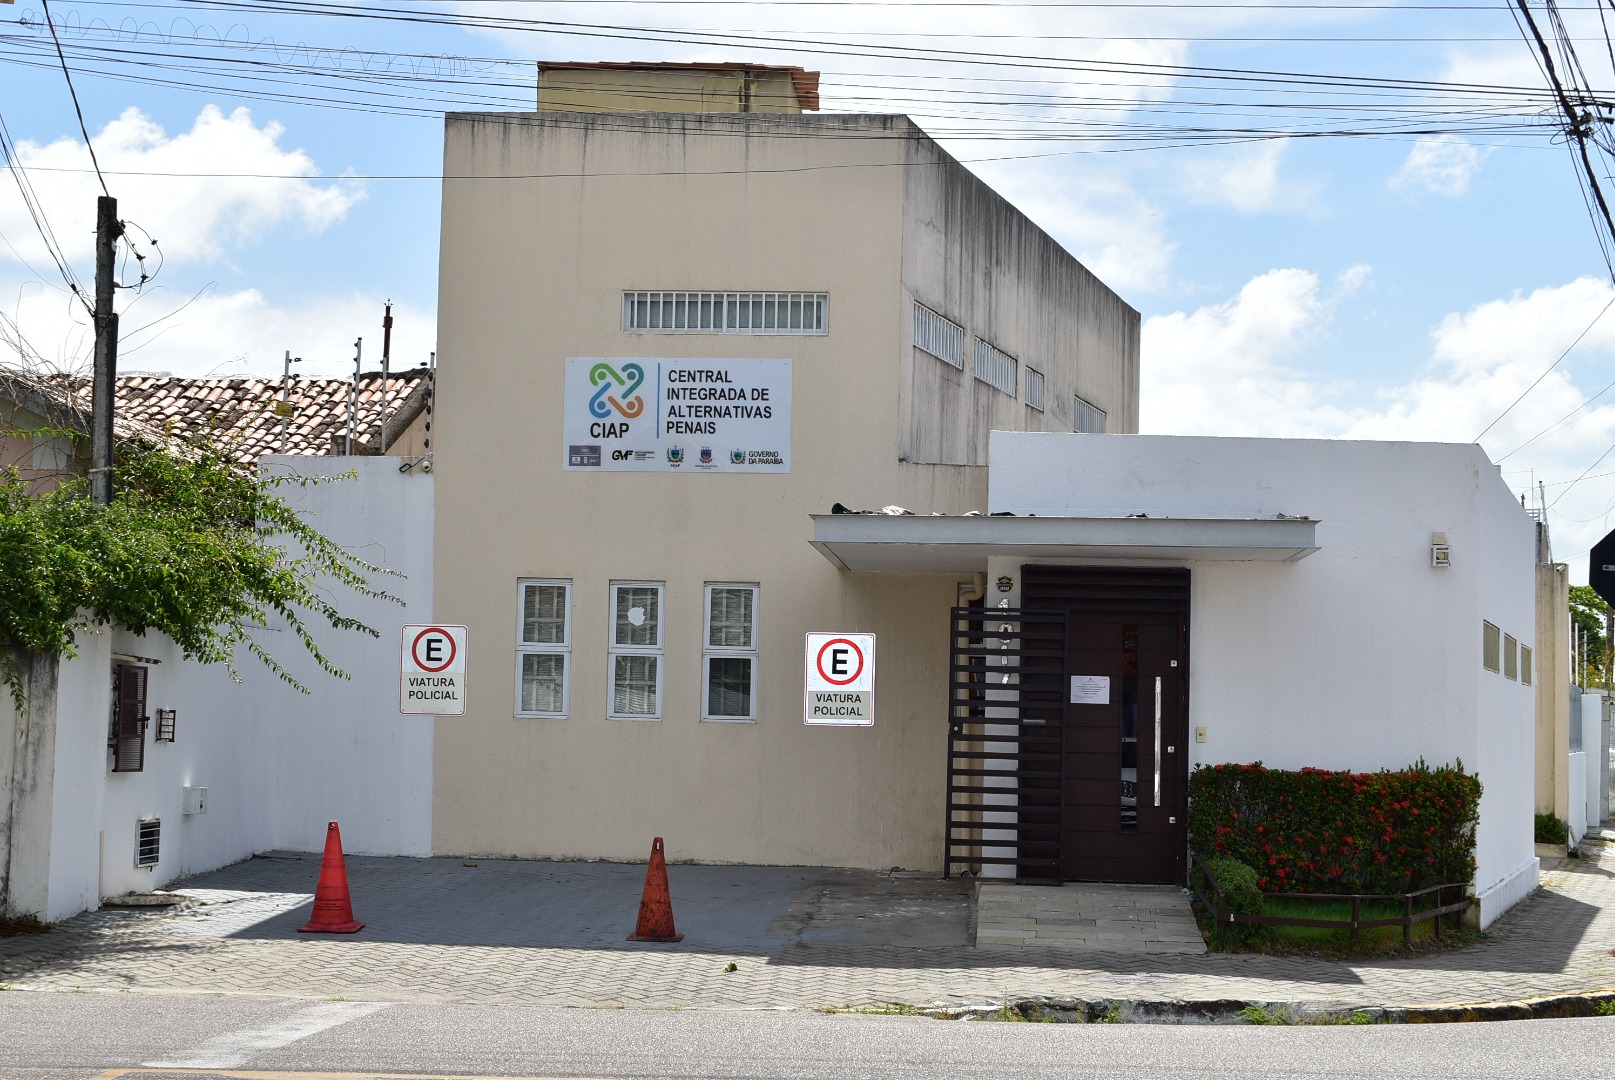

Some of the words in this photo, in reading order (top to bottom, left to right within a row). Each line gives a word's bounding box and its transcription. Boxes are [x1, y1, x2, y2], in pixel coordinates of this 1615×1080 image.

[668, 370, 732, 383] CENTRAL
[667, 388, 747, 401] INTEGRADA
[751, 388, 770, 401] DE
[667, 405, 772, 419] ALTERNATIVAS
[590, 422, 630, 439] CIAP
[666, 421, 716, 434] PENAIS
[748, 450, 779, 458] GOVERNO
[426, 639, 443, 661] E
[832, 649, 848, 675] E
[408, 677, 455, 687] VIATURA
[408, 690, 458, 700] POLICIAL
[815, 693, 862, 703] VIATURA
[814, 706, 863, 716] POLICIAL
